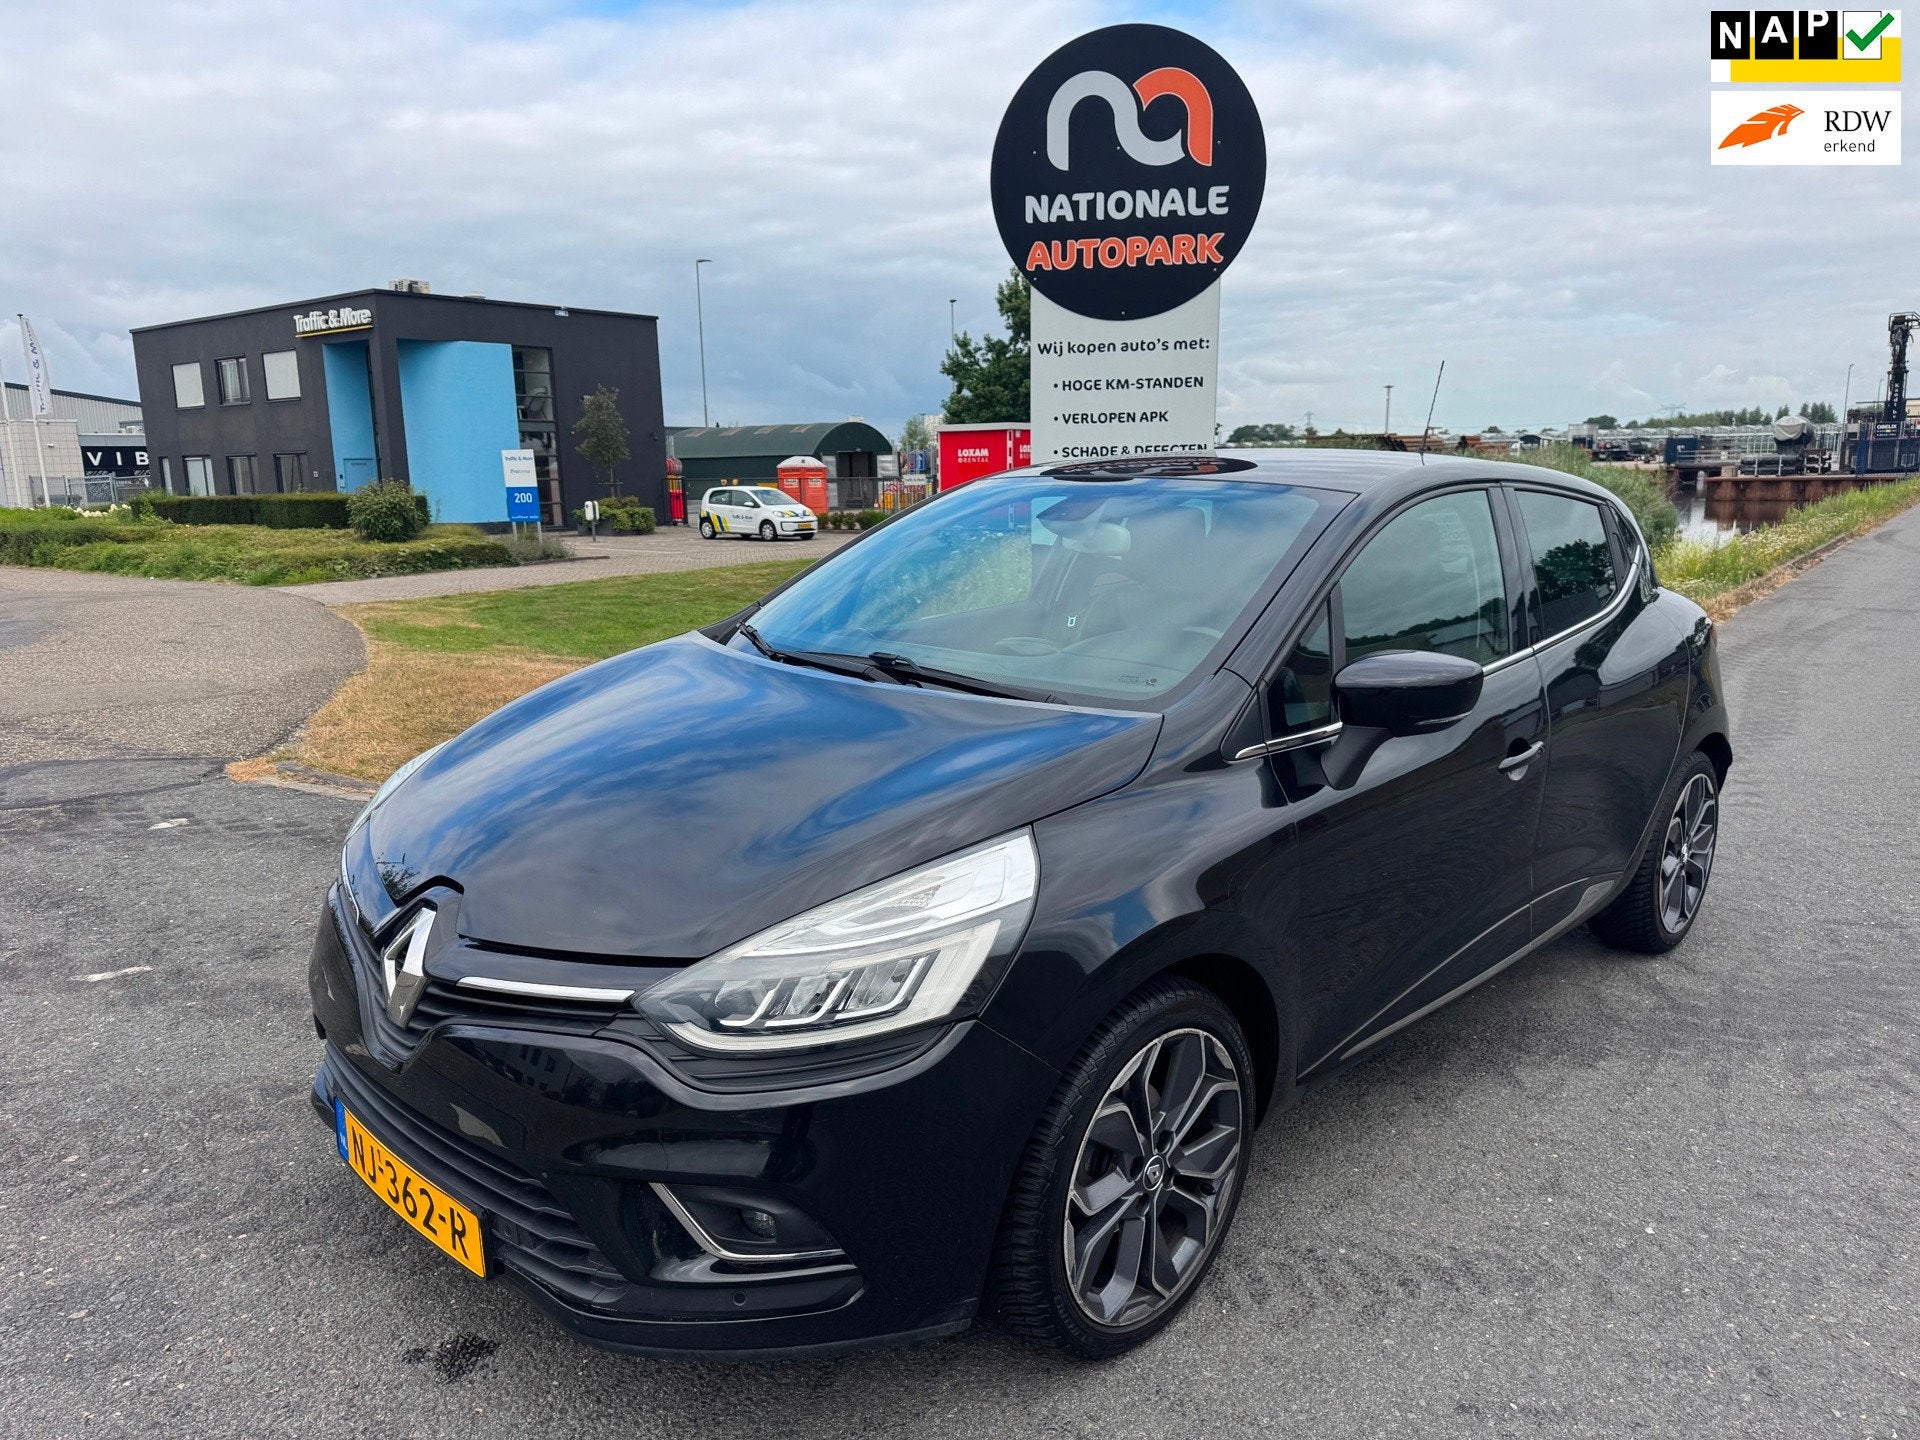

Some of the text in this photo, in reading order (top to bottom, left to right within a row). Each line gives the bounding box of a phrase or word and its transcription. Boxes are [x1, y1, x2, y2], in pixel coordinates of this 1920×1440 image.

[1024, 185, 1230, 224] NATIONALE
[1025, 232, 1226, 271] AUTOPARK
[293, 307, 372, 333] Traffic & More
[1037, 337, 1210, 357] Wij kopen auto's met:
[1062, 376, 1204, 392] HOGE KM-STANDEN
[1062, 410, 1169, 424] VERLOPEN APK
[957, 448, 989, 457] LOXAM
[1062, 445, 1118, 458] SCHADE
[1120, 445, 1131, 455] &
[514, 492, 533, 503] 200
[351, 1124, 469, 1261] NJ-362-R
